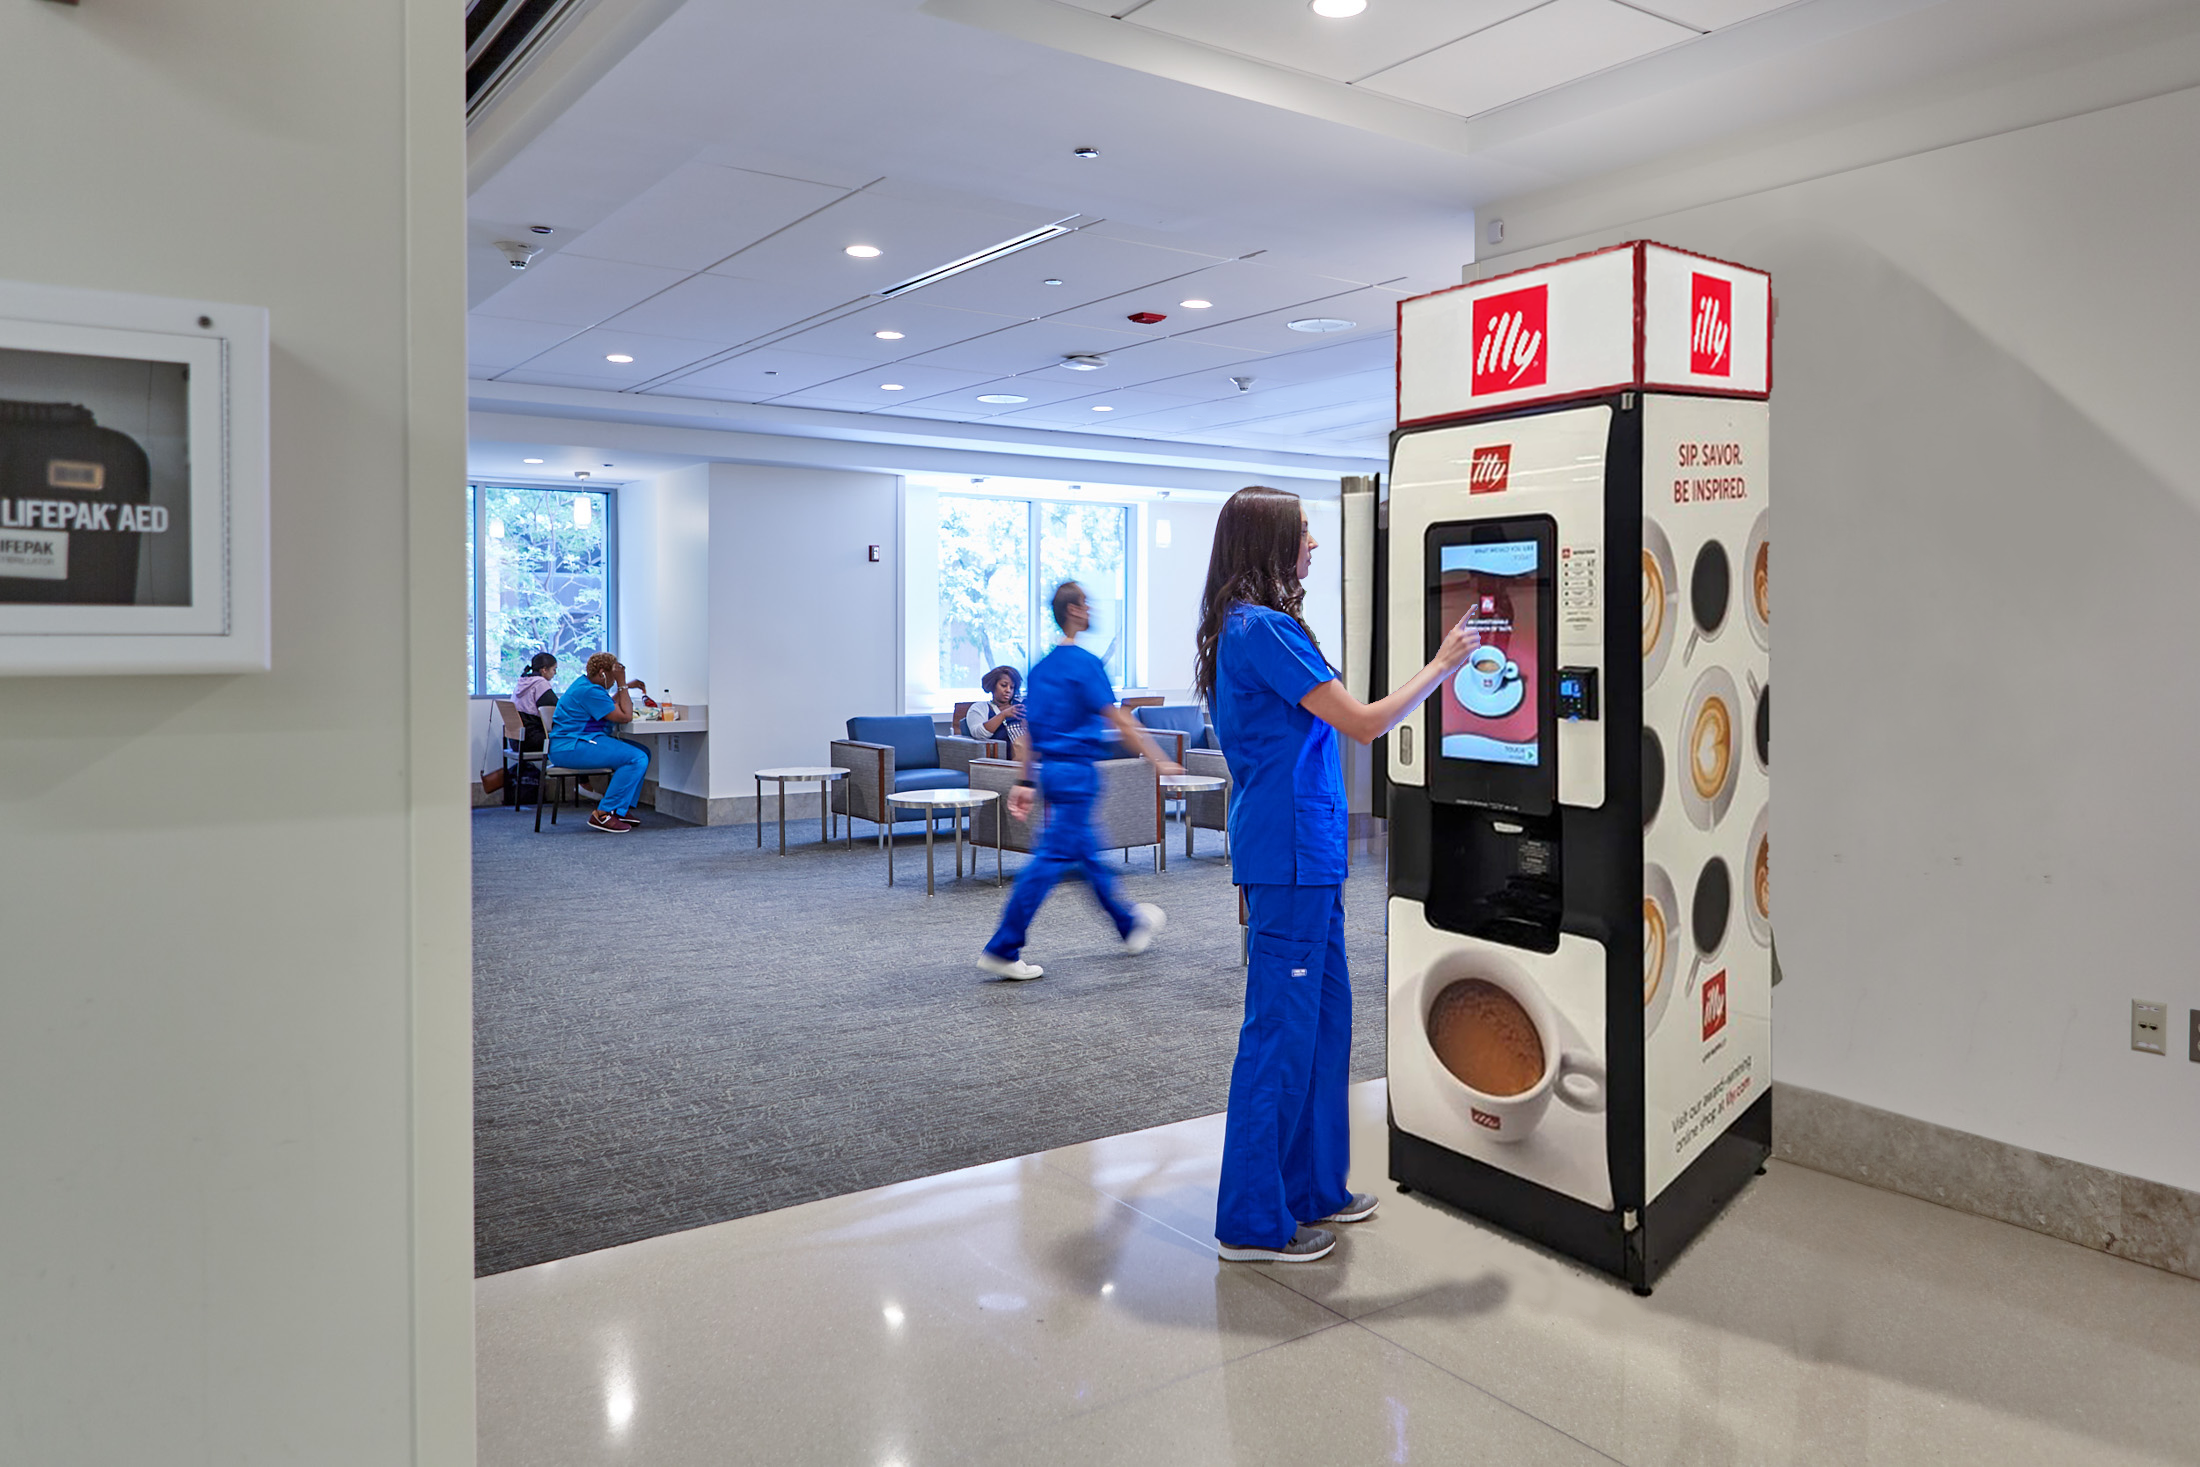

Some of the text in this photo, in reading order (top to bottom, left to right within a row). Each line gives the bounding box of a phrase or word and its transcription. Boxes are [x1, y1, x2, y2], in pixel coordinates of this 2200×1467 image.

[1477, 310, 1542, 384] illy
[1693, 296, 1728, 369] illy
[1473, 453, 1506, 488] illy
[1678, 443, 1743, 466] SIP. SAVOR.
[1674, 477, 1747, 503] BE INSPIRED.
[117, 504, 168, 532] AED
[0, 539, 54, 555] IFEPAK
[1703, 983, 1725, 1027] illy
[1672, 1111, 1688, 1134] Visit
[1689, 1100, 1702, 1119] our
[1675, 1125, 1699, 1153] online
[1700, 1109, 1717, 1132] shop
